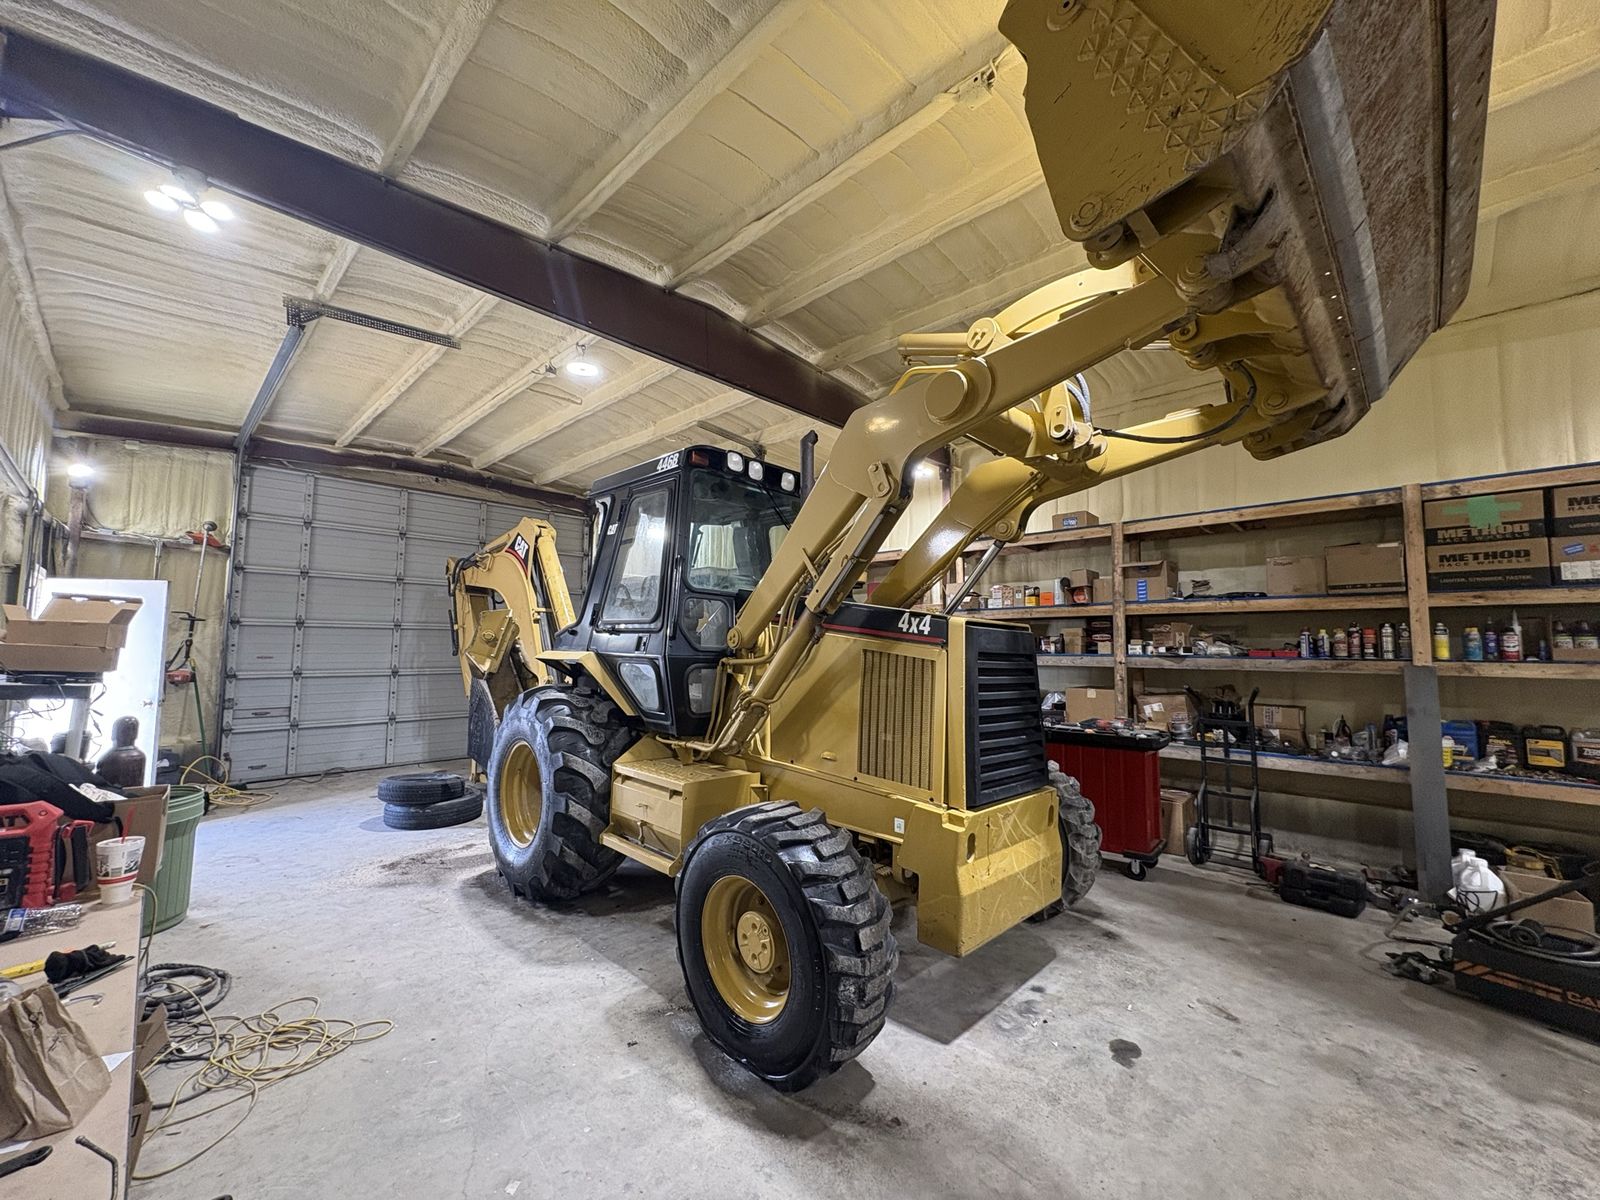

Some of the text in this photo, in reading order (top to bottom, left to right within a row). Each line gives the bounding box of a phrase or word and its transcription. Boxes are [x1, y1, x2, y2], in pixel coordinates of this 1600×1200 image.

[656, 452, 679, 471] 446B
[607, 523, 618, 535] CAT
[1437, 522, 1530, 539] METHOD
[514, 535, 529, 559] CAT
[1439, 549, 1531, 563] METHOD
[1476, 558, 1531, 566] WHEELS
[898, 612, 932, 635] 4x4
